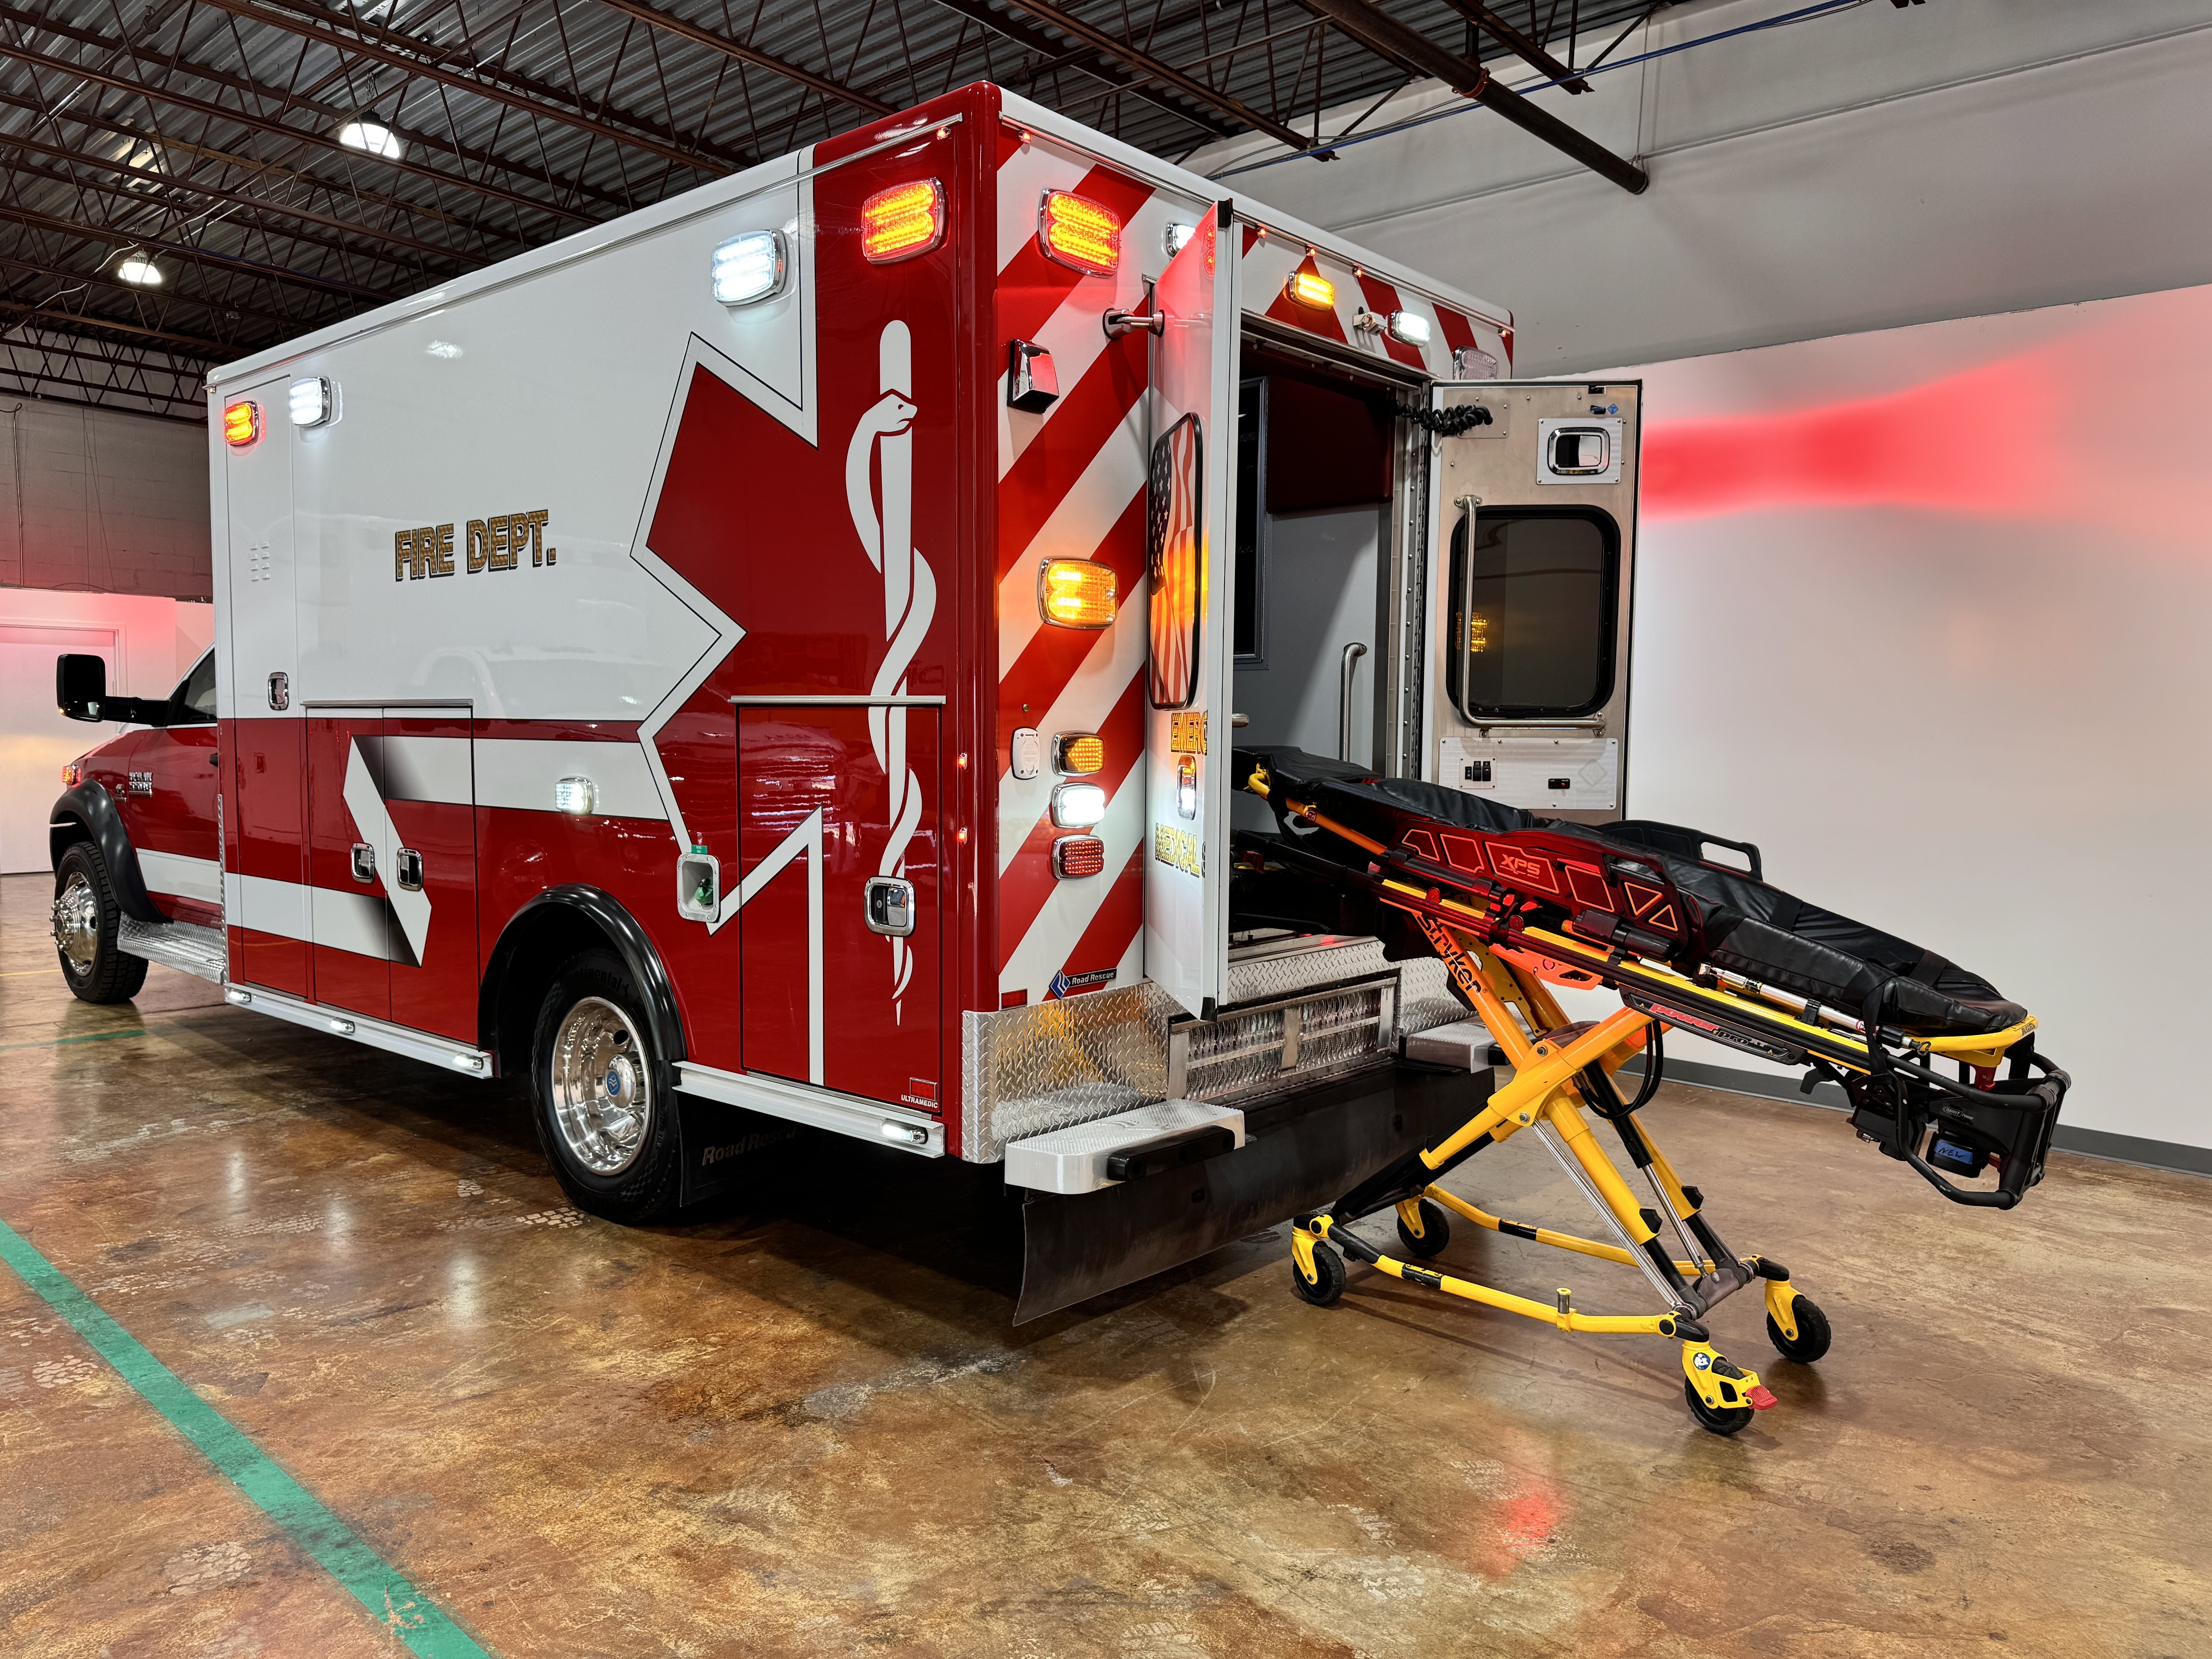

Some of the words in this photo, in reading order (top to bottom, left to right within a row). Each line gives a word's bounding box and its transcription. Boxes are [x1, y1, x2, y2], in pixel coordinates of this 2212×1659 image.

[395, 524, 455, 582] FIRE
[467, 509, 556, 574] DEPT.
[1155, 823, 1200, 878] MEDICAL
[1501, 854, 1540, 875] XPS
[1072, 975, 1089, 985] Road
[1090, 972, 1114, 982] Rescue
[1649, 1003, 1719, 1031] power
[901, 1094, 938, 1109] ULTRAMEDIC
[701, 1135, 745, 1166] Road
[747, 1125, 805, 1151] Rescue
[1938, 1147, 1965, 1158] NEW
